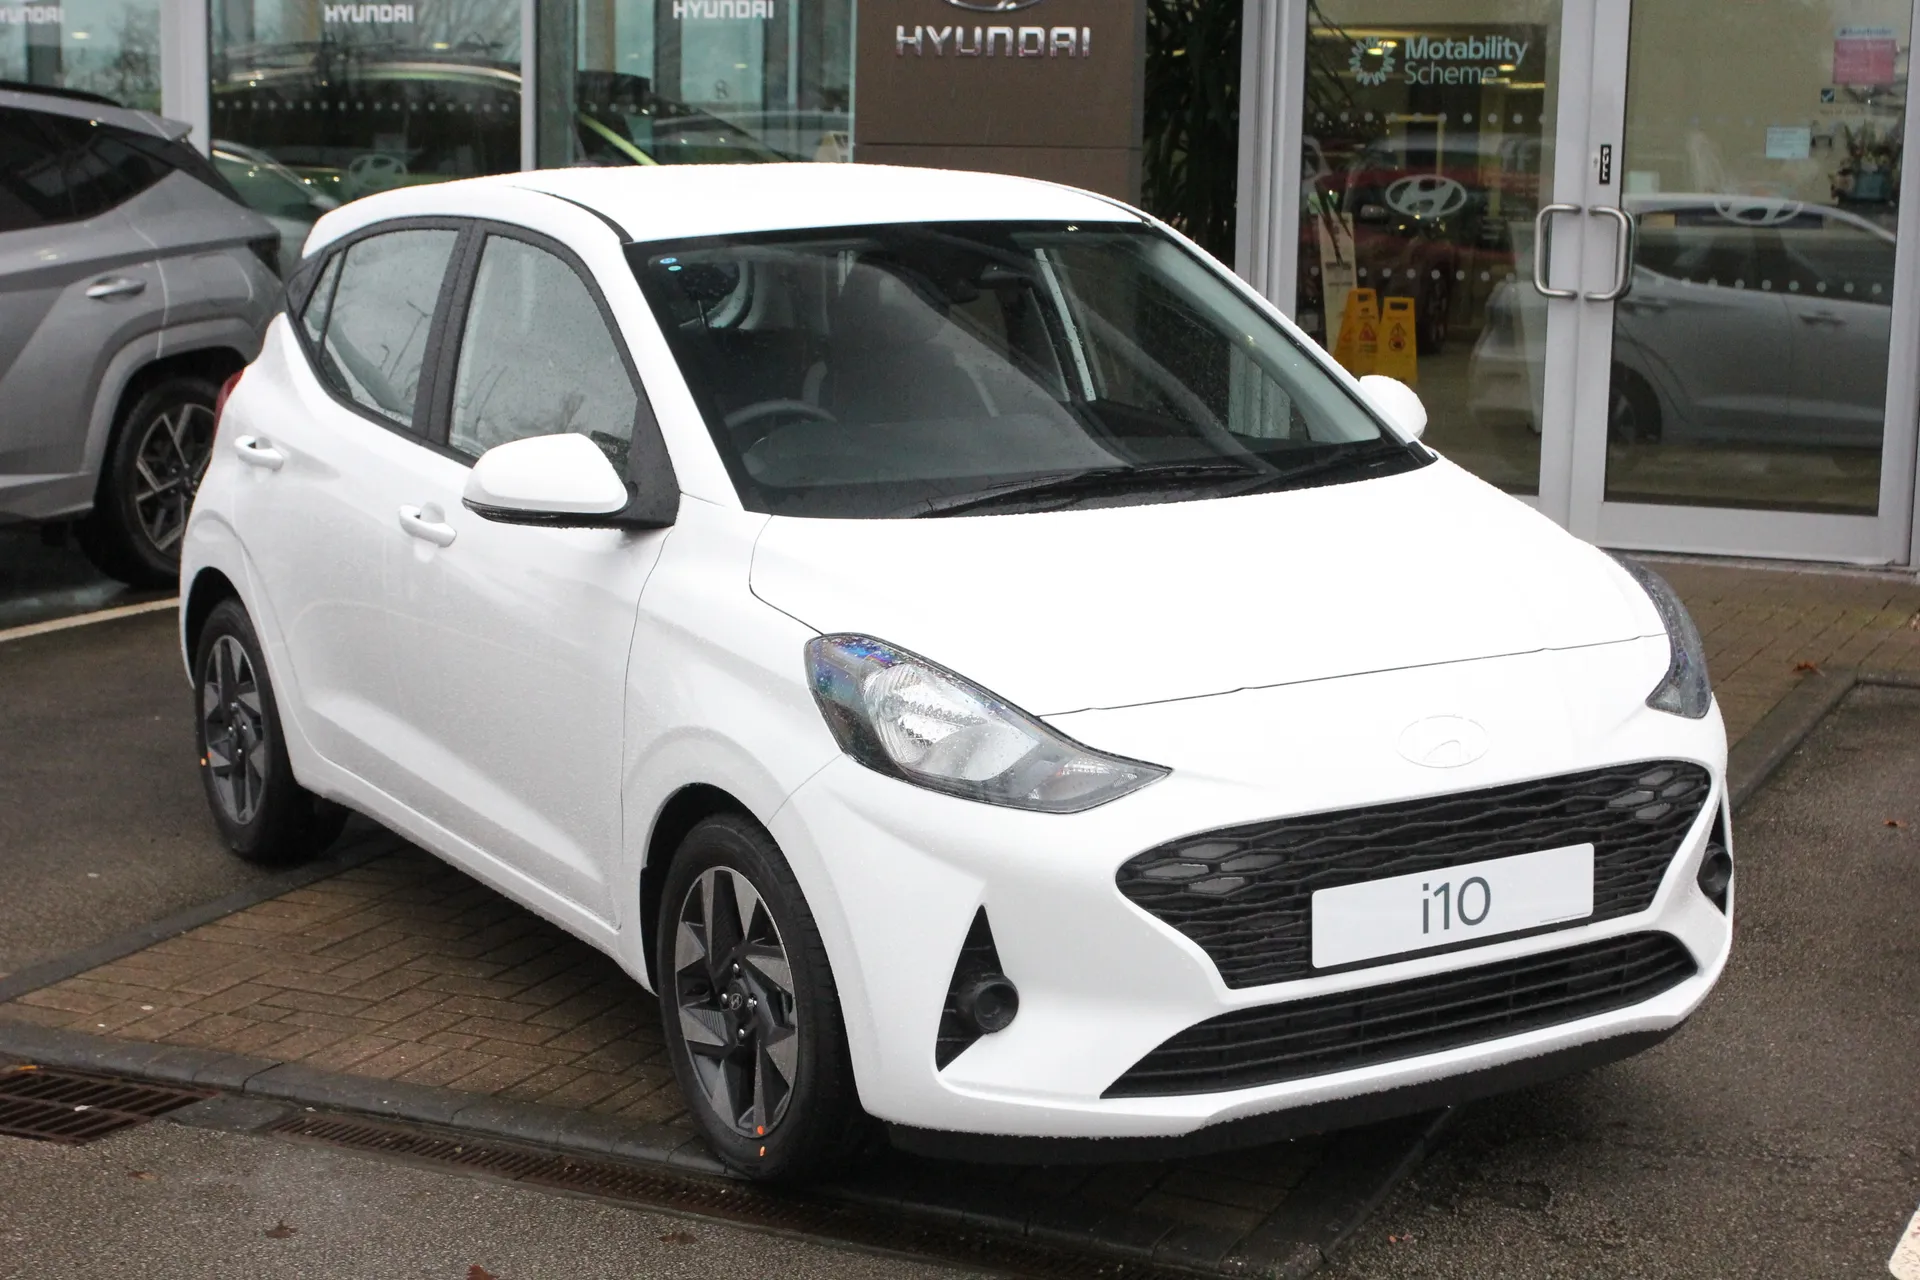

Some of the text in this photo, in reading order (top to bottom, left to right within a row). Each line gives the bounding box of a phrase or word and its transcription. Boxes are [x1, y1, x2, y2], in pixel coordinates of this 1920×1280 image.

[324, 4, 414, 23] HYUNDAI
[672, 0, 774, 19] HYUNDAI
[896, 25, 1091, 57] HYUNDAI
[1404, 35, 1528, 66] Motability
[1403, 60, 1497, 85] Scheme
[1602, 147, 1610, 181] PULL
[1423, 876, 1491, 934] i10
